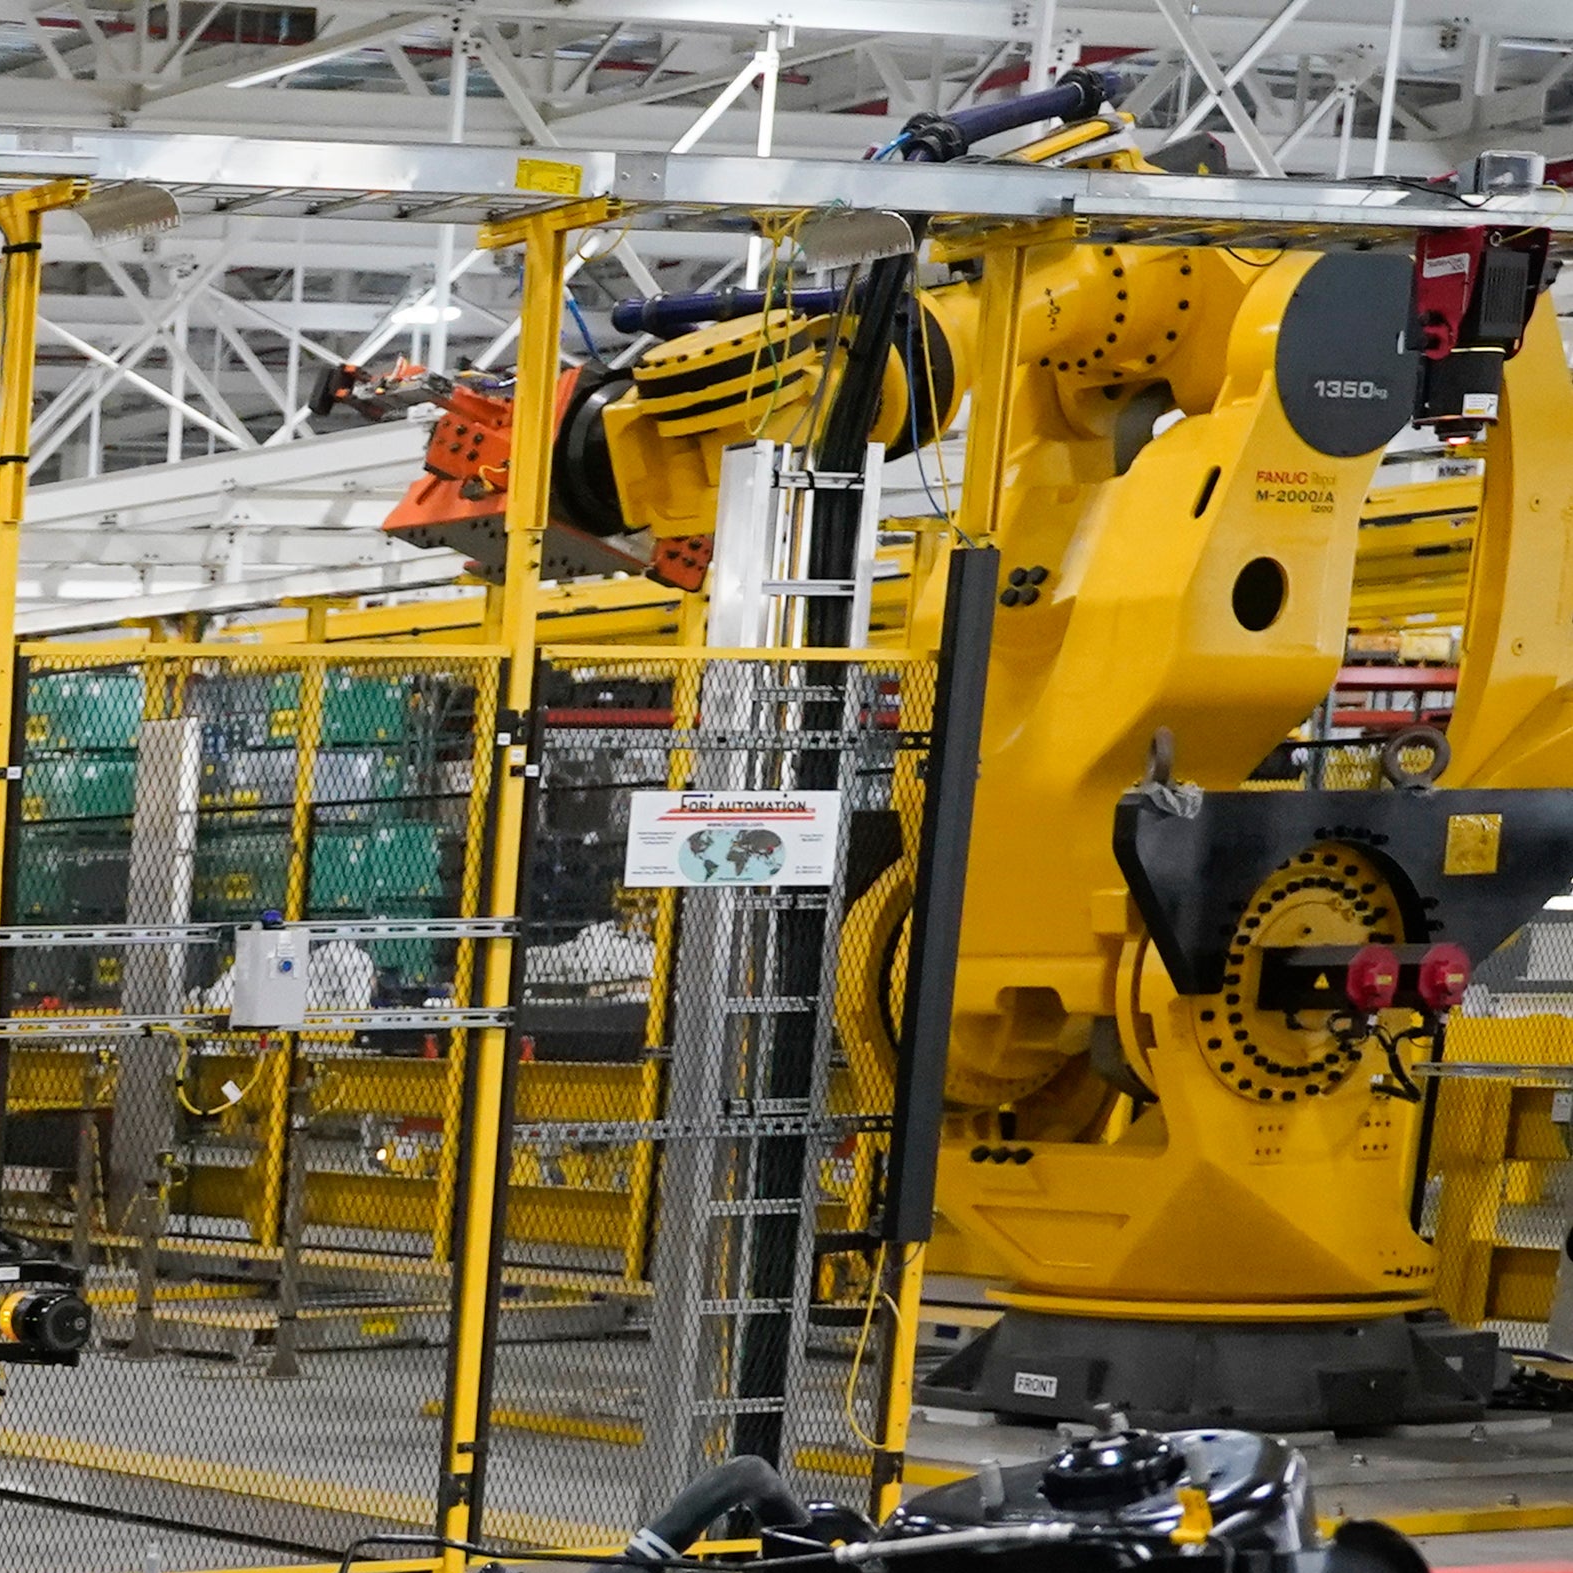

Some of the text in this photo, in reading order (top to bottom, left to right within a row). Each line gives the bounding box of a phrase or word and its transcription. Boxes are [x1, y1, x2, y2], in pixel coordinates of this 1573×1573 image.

[1256, 471, 1309, 485] FANUC
[717, 794, 806, 813] AUTOMATION
[1017, 1376, 1055, 1393] FRONT
